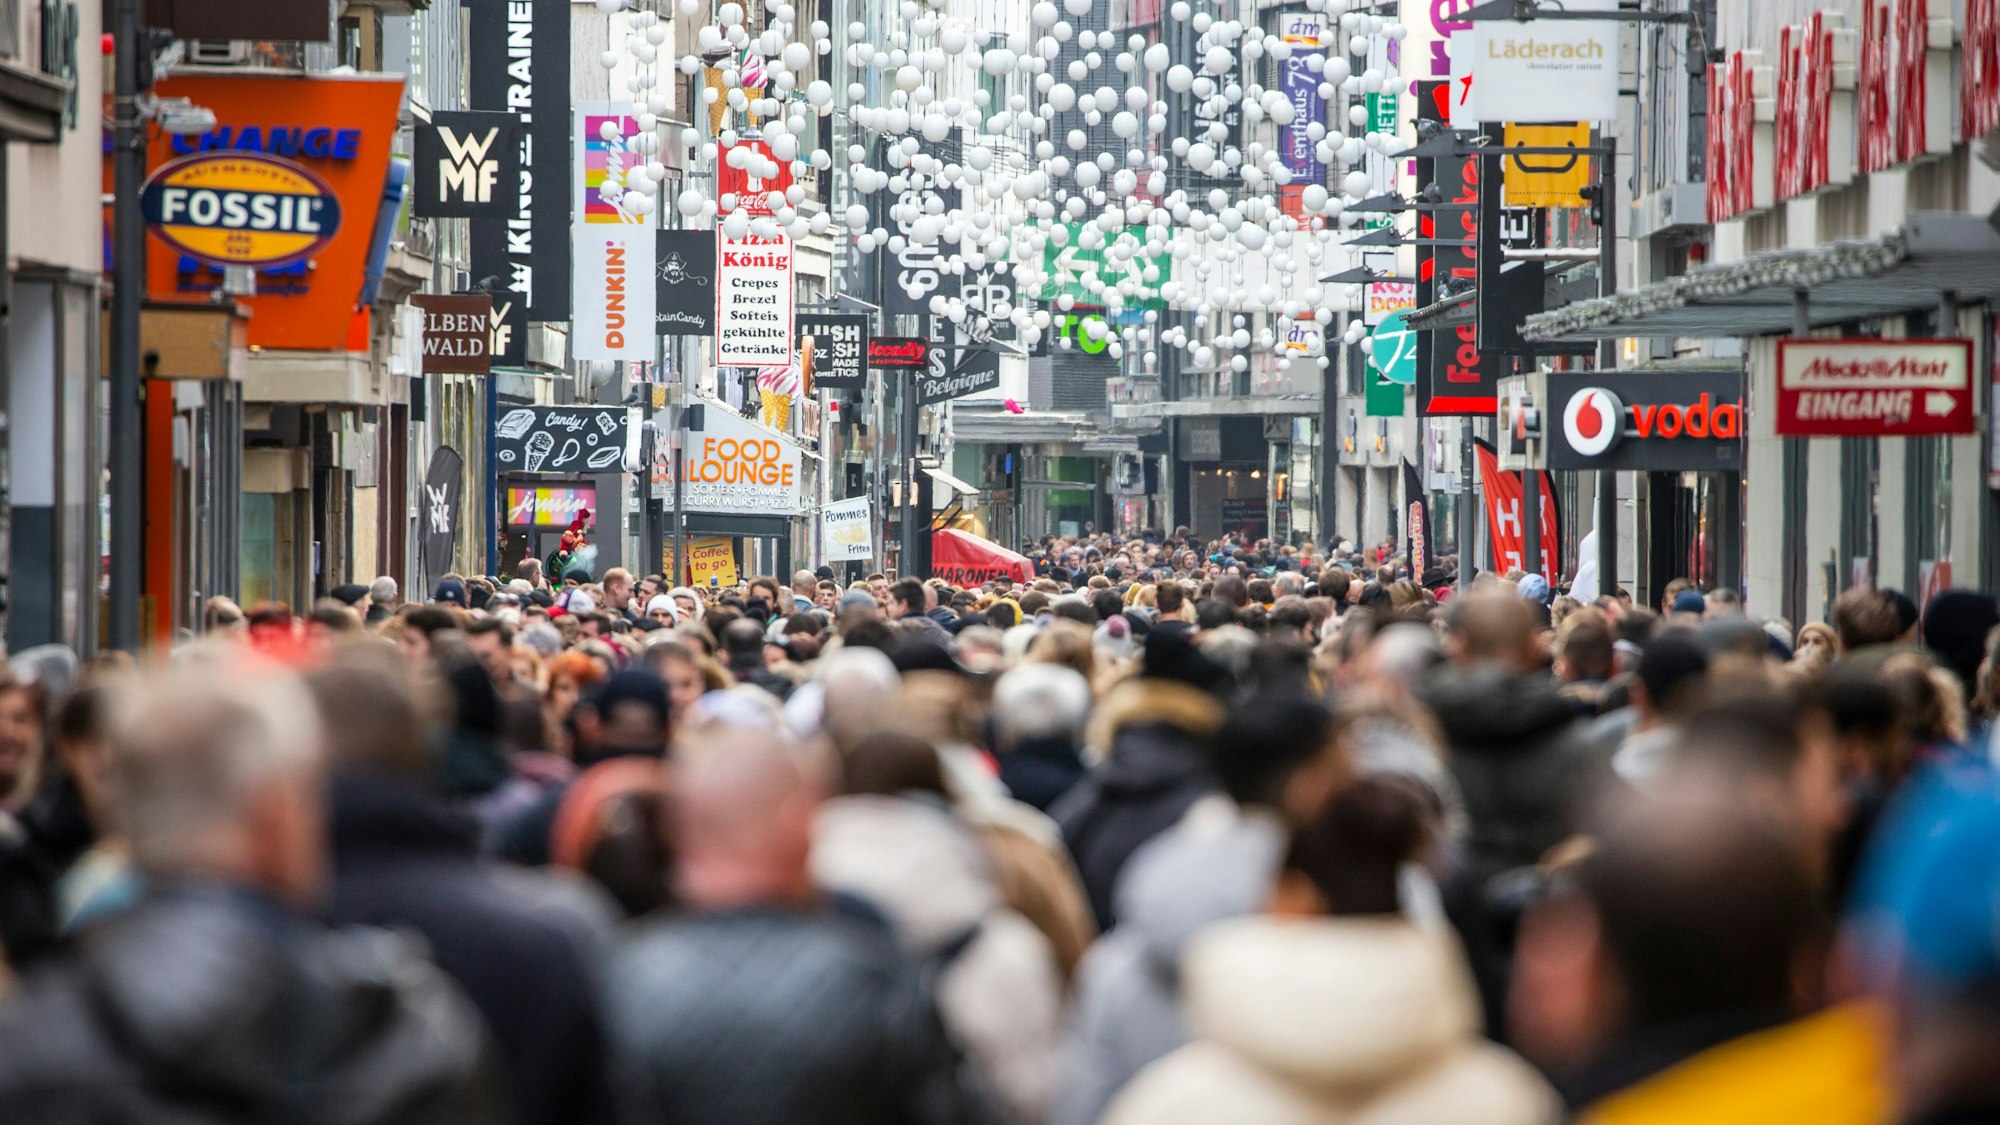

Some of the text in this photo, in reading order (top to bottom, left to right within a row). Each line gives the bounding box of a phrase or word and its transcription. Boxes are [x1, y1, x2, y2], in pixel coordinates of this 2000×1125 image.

[1290, 18, 1320, 35] dm
[1488, 38, 1603, 59] Läderach
[172, 125, 362, 159] CHANGE
[436, 126, 499, 203] WMF
[161, 188, 321, 232] FOSSIL
[723, 252, 788, 270] König
[1447, 154, 1481, 383] Foo Locke
[731, 278, 778, 290] Crepes
[732, 294, 777, 304] Brezel
[423, 313, 487, 333] LBEN
[730, 310, 778, 321] Softeis
[723, 327, 785, 339] gekühlte
[802, 324, 860, 342] LUSH
[422, 338, 484, 357] WALD
[721, 343, 787, 355] Getränke
[833, 343, 860, 357] SH
[869, 340, 926, 361] iccadly
[924, 370, 995, 398] Belgique
[1632, 392, 1743, 439] voda
[1796, 391, 1914, 424] EINGANG
[545, 412, 588, 432] Candy!
[704, 438, 781, 462] FOOD
[690, 459, 793, 486] LOUNGE
[693, 484, 790, 498] SOFTEIS POMMES
[686, 495, 759, 509] CURRYWURST
[767, 499, 796, 510] PIZZA
[825, 508, 867, 523] Pommes
[692, 547, 730, 560] Coffee
[848, 544, 870, 555] Frites
[695, 559, 728, 572] to go
